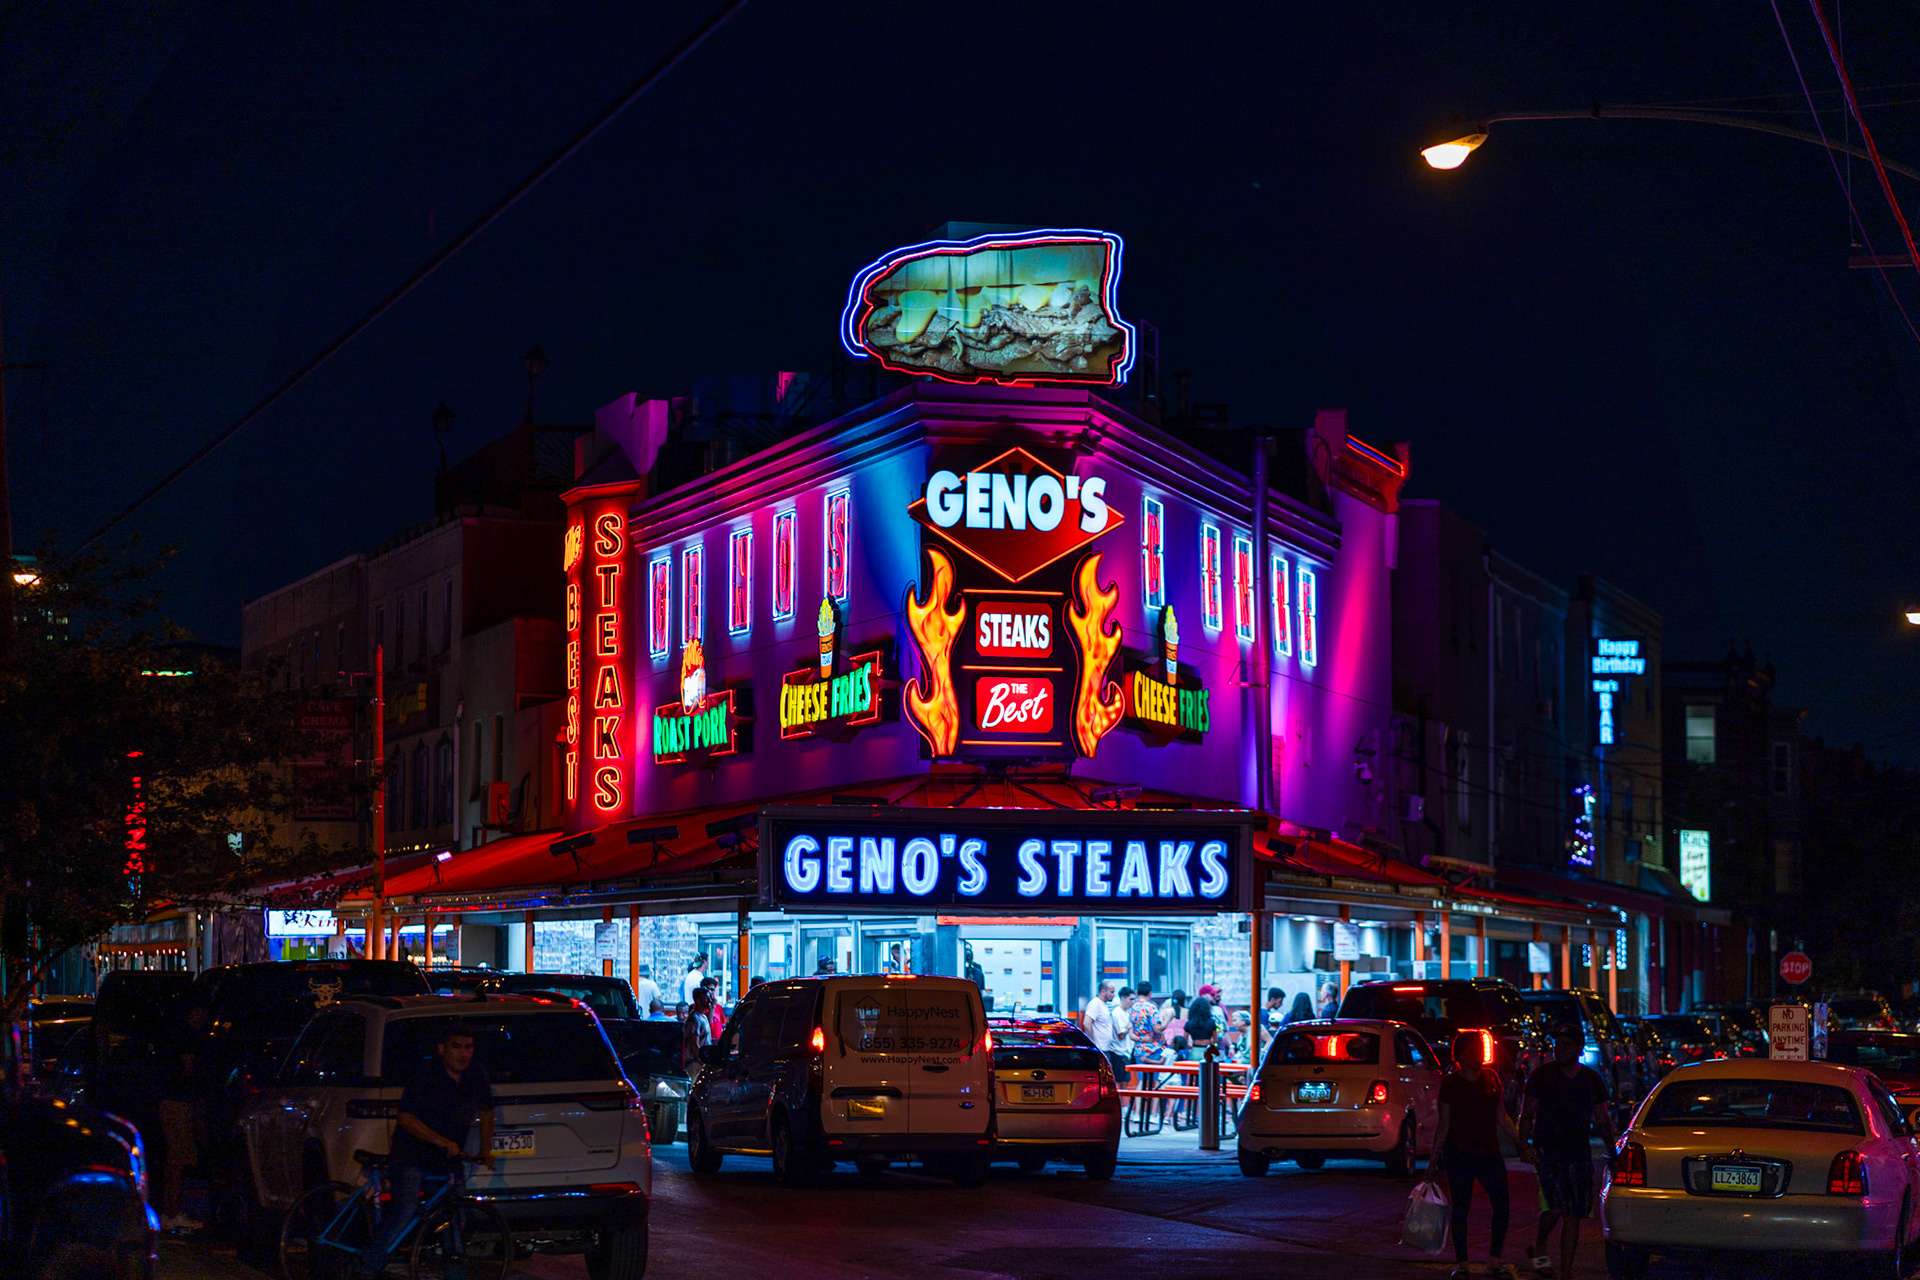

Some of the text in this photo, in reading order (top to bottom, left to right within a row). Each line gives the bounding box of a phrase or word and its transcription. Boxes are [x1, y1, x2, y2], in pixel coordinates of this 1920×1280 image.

[926, 470, 1109, 534] GENO'S
[979, 612, 1051, 650] STEAKS
[594, 512, 624, 811] STEAKS
[566, 584, 580, 801] BEST
[779, 661, 873, 729] CHEESE FRIES
[981, 682, 1049, 729] Best
[1010, 682, 1028, 695] THE
[1132, 669, 1211, 734] CHEESE FRIES
[653, 700, 728, 756] ROAST PORK
[1599, 692, 1614, 745] BAR
[784, 833, 1230, 899] GENO'S STEAKS
[1783, 961, 1809, 974] STOP
[887, 1005, 961, 1020] HappyNest
[1772, 1023, 1805, 1032] PARKING
[1782, 1010, 1794, 1020] NO
[859, 1037, 961, 1051] (855) 335-9274
[860, 1055, 962, 1066] www.HappyNest.com
[1772, 1035, 1806, 1045] ANYTIME
